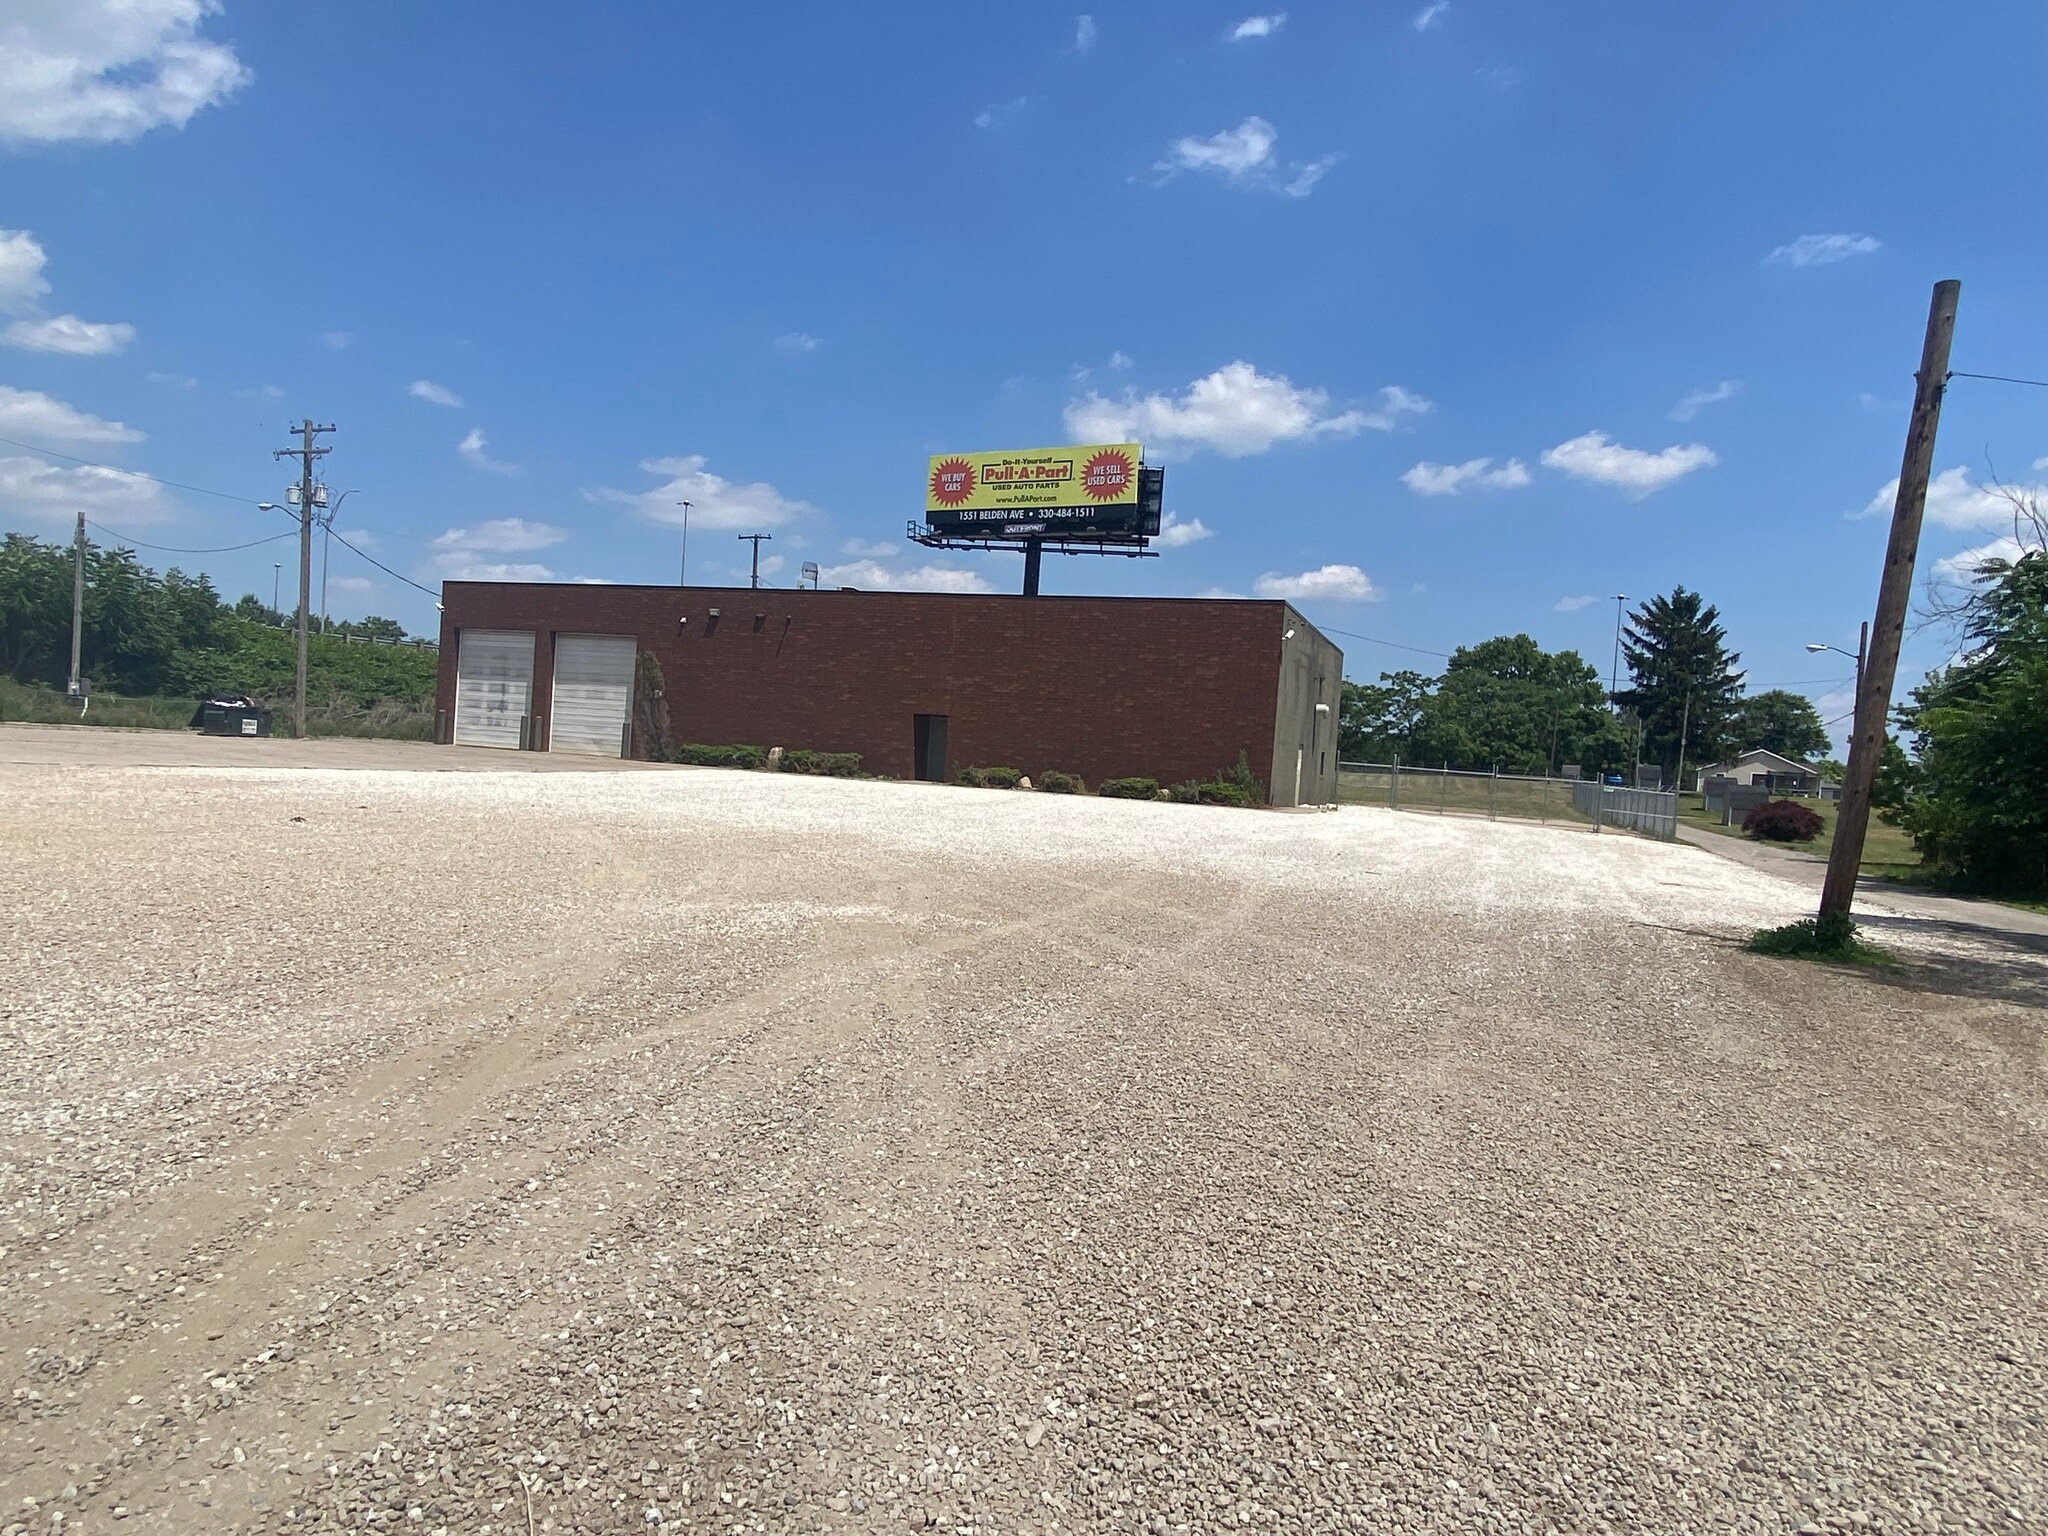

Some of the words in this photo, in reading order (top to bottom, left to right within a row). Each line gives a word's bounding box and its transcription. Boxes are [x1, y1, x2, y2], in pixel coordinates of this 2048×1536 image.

[1002, 457, 1053, 465] Do-It-Yourself
[1093, 465, 1105, 475] WE
[1106, 464, 1122, 474] SELL
[941, 473, 952, 482] WE
[953, 472, 966, 481] BUY
[1087, 476, 1105, 486] USED
[1106, 474, 1126, 484] CARS
[944, 482, 961, 492] CARS
[995, 494, 1057, 503] www.PullAPart.com
[959, 511, 977, 521] 1551
[979, 510, 1008, 520] BELDEN
[1009, 510, 1025, 519] AVE
[1038, 507, 1095, 519] 330-484-1511
